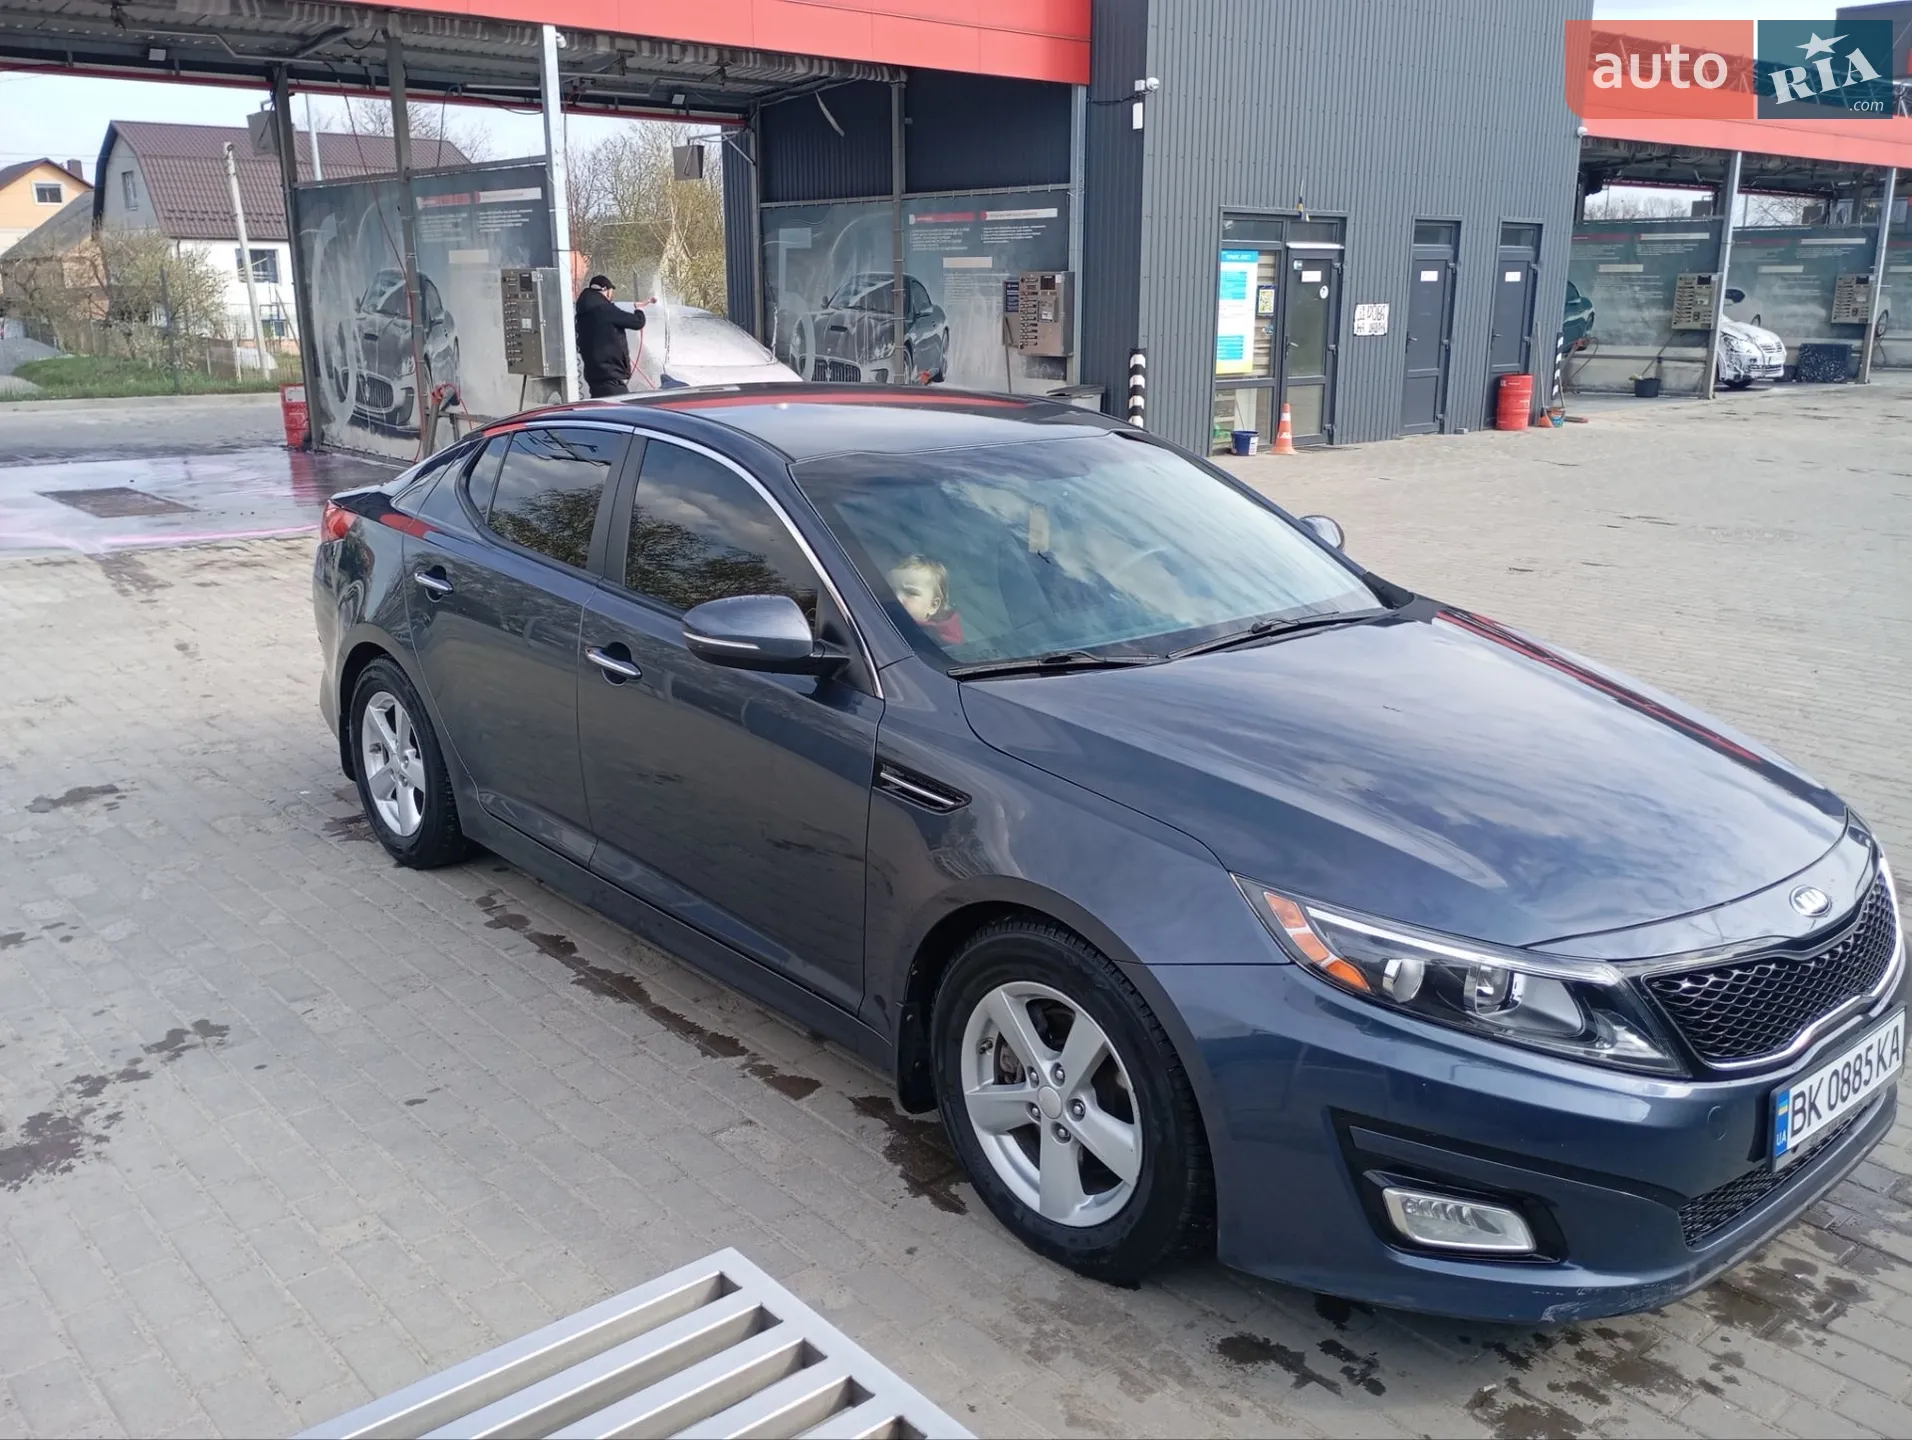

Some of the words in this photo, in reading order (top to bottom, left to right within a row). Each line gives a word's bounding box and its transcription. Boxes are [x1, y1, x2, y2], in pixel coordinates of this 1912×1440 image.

[1790, 1077, 1824, 1138] BK
[1827, 1043, 1873, 1112] 0885
[1875, 1024, 1900, 1078] KA
[1776, 1132, 1787, 1146] UA
